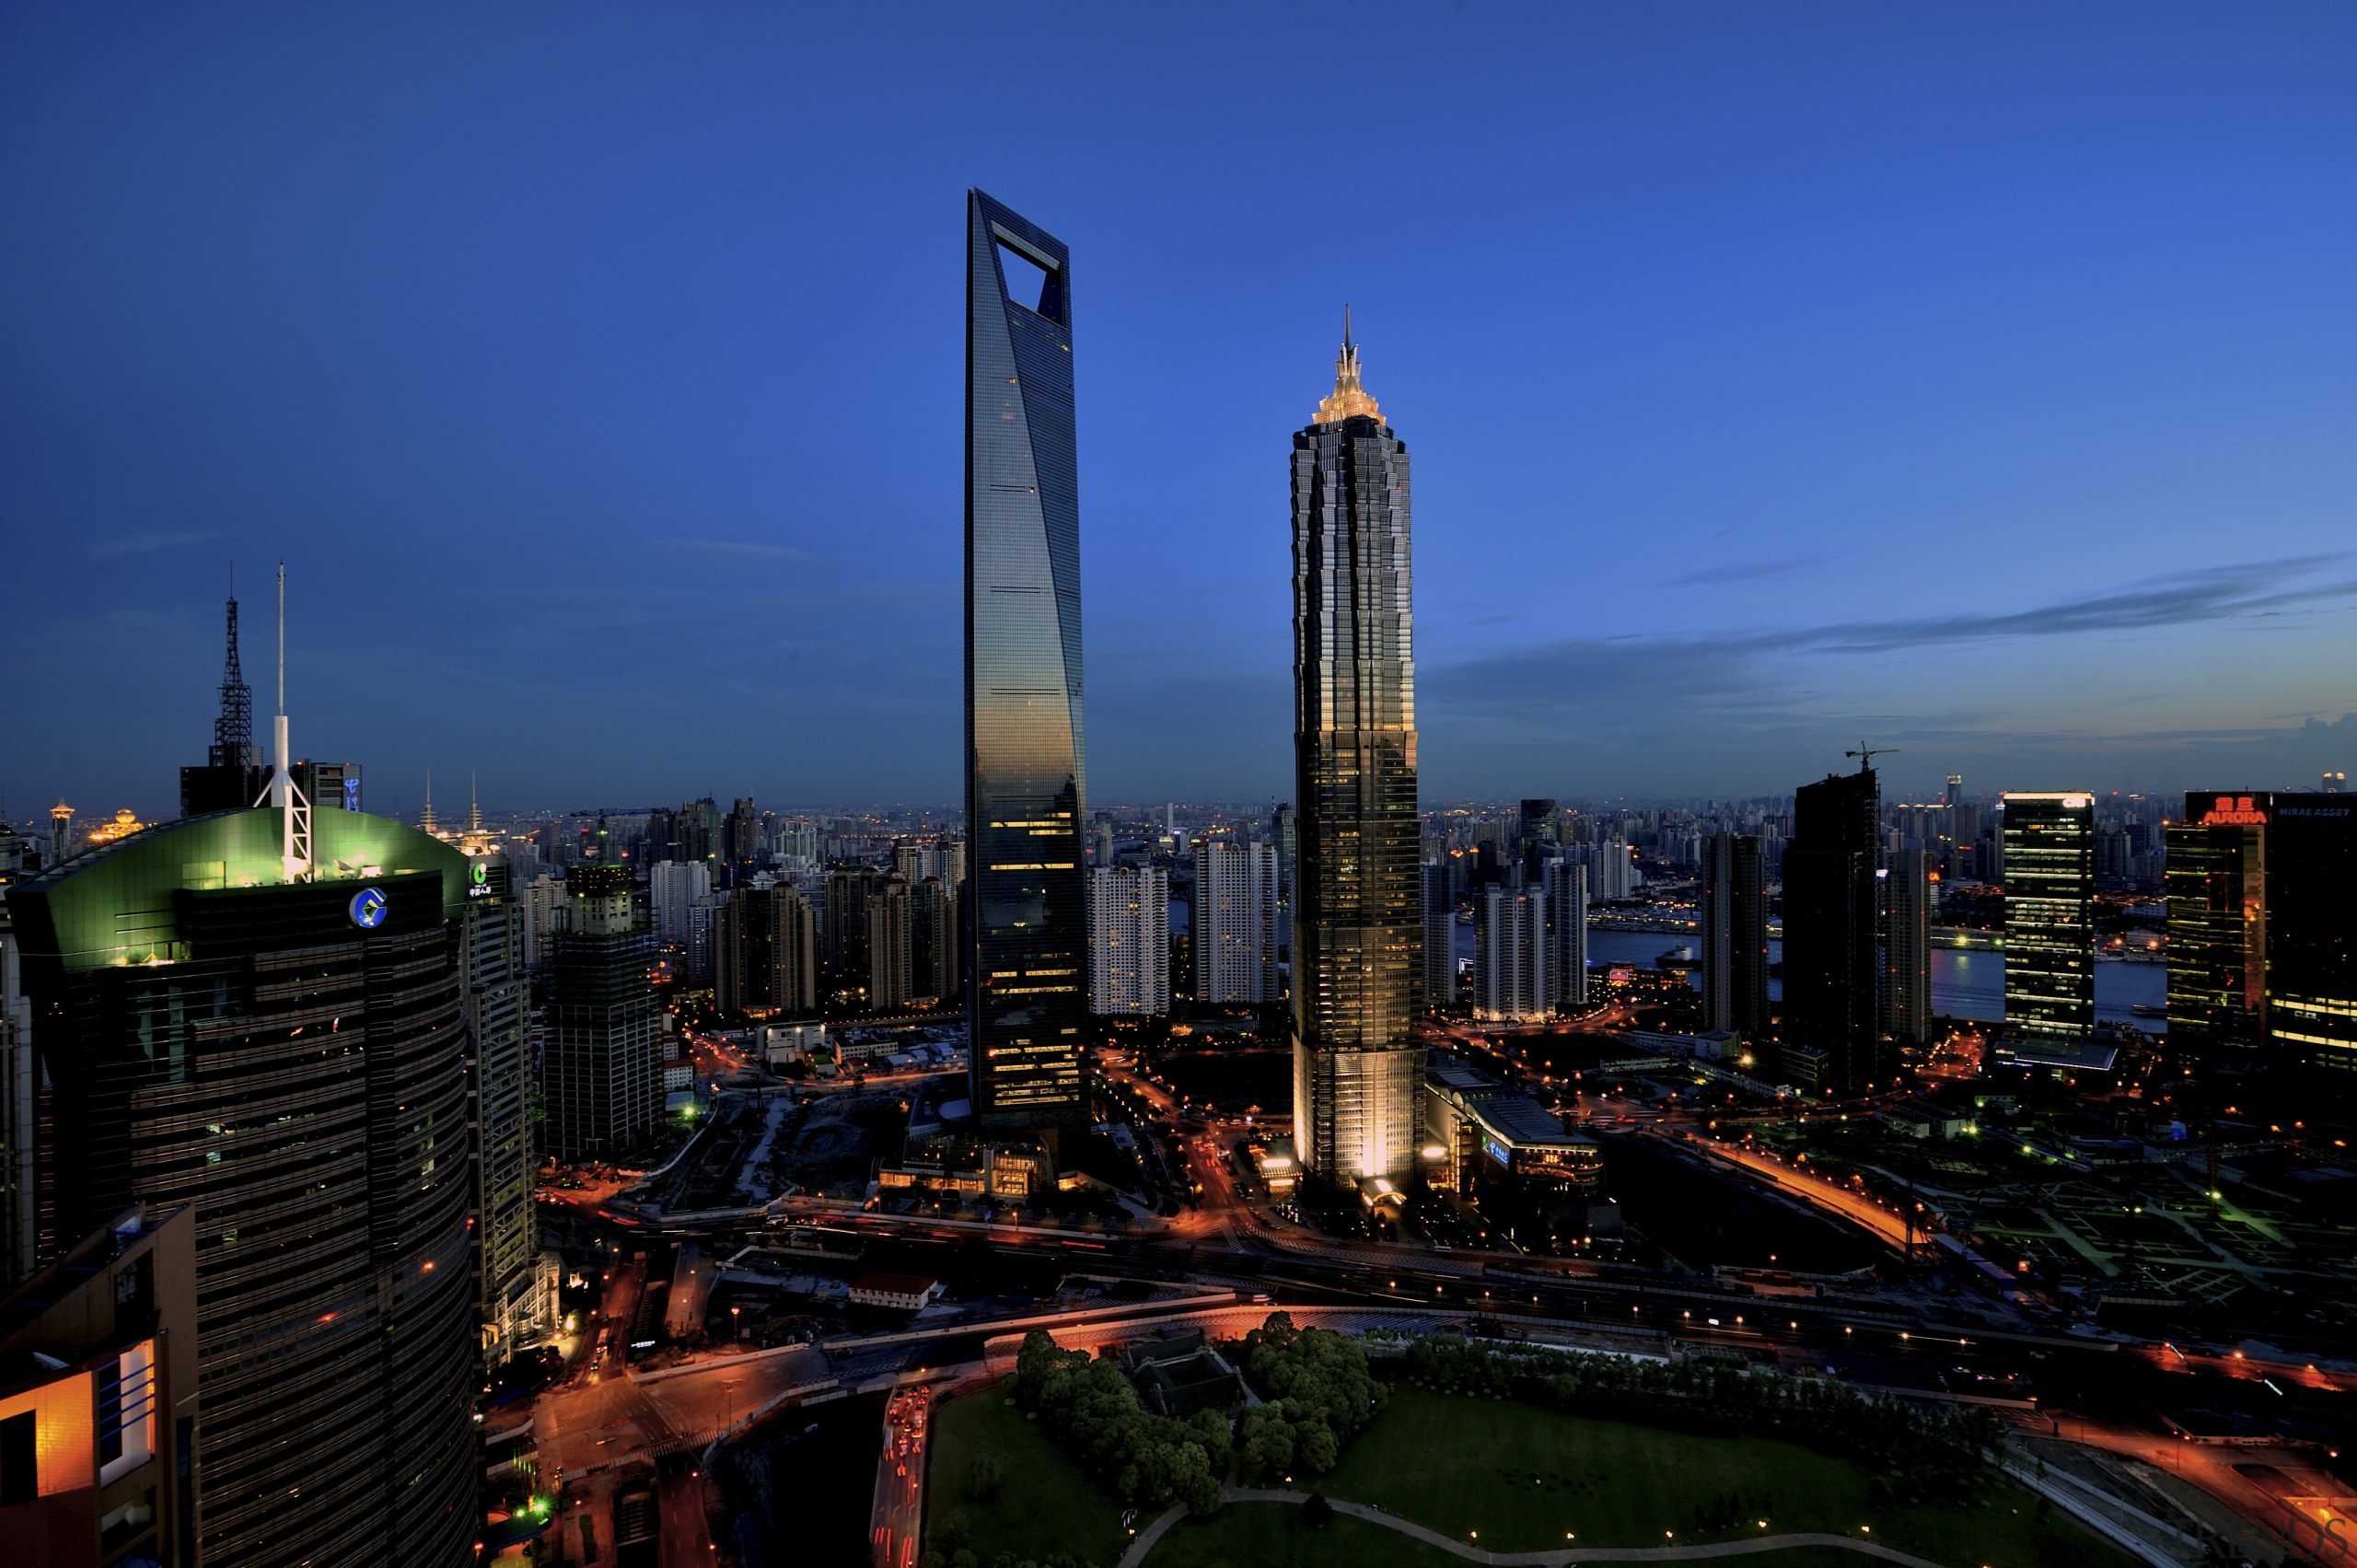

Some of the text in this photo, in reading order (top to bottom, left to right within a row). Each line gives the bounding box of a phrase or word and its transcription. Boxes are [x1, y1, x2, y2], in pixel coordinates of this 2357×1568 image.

[2202, 810, 2268, 824] AURORA
[2279, 807, 2351, 817] MIRAE ASSET
